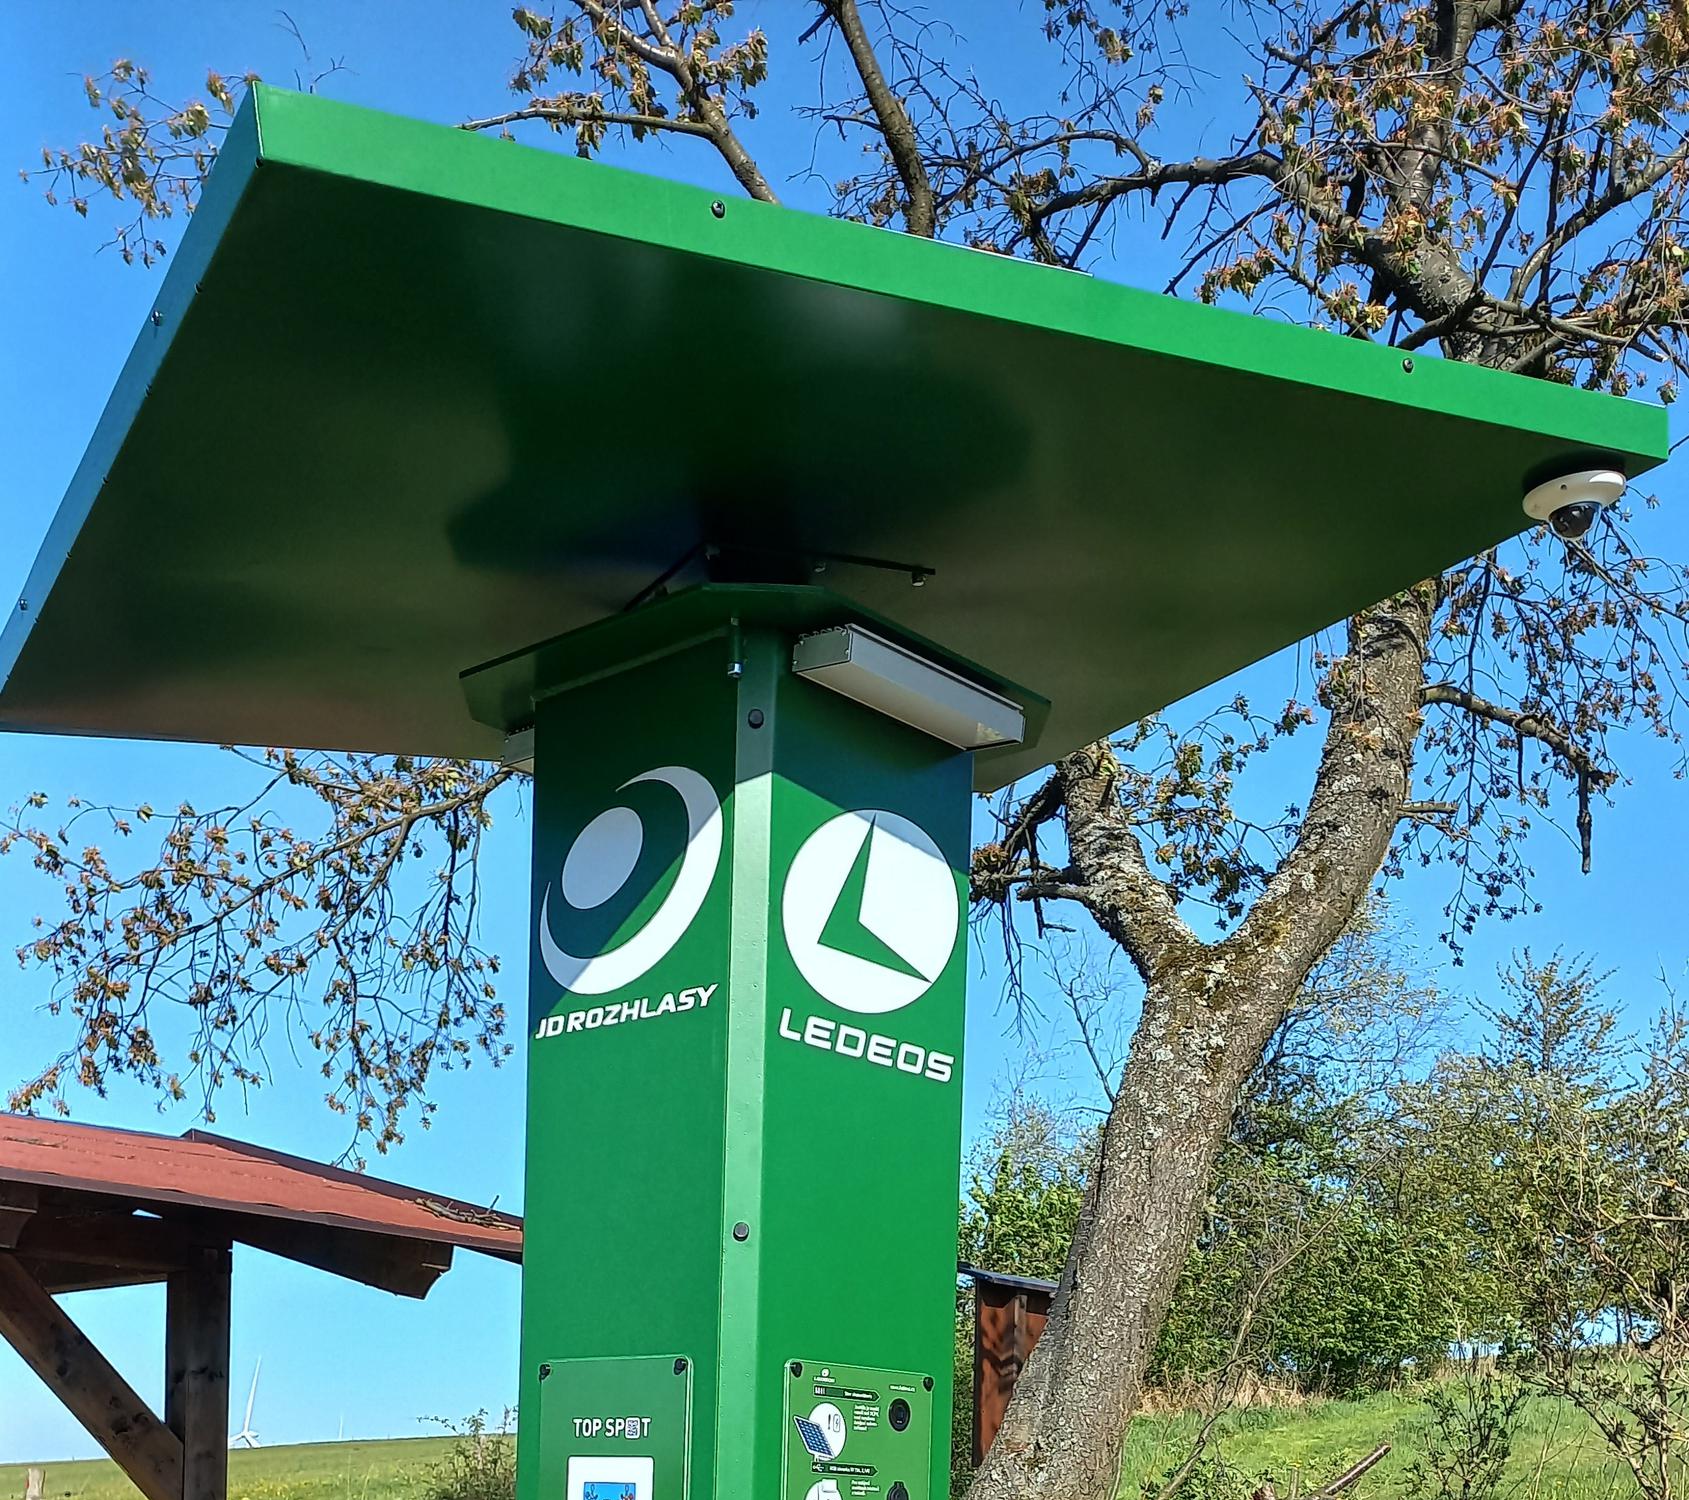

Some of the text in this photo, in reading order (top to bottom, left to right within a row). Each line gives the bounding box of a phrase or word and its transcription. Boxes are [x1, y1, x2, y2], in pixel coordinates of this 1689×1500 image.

[535, 984, 718, 1039] JD ROZHLASY
[779, 1007, 955, 1083] LEDEOS
[573, 1418, 602, 1437] TOP
